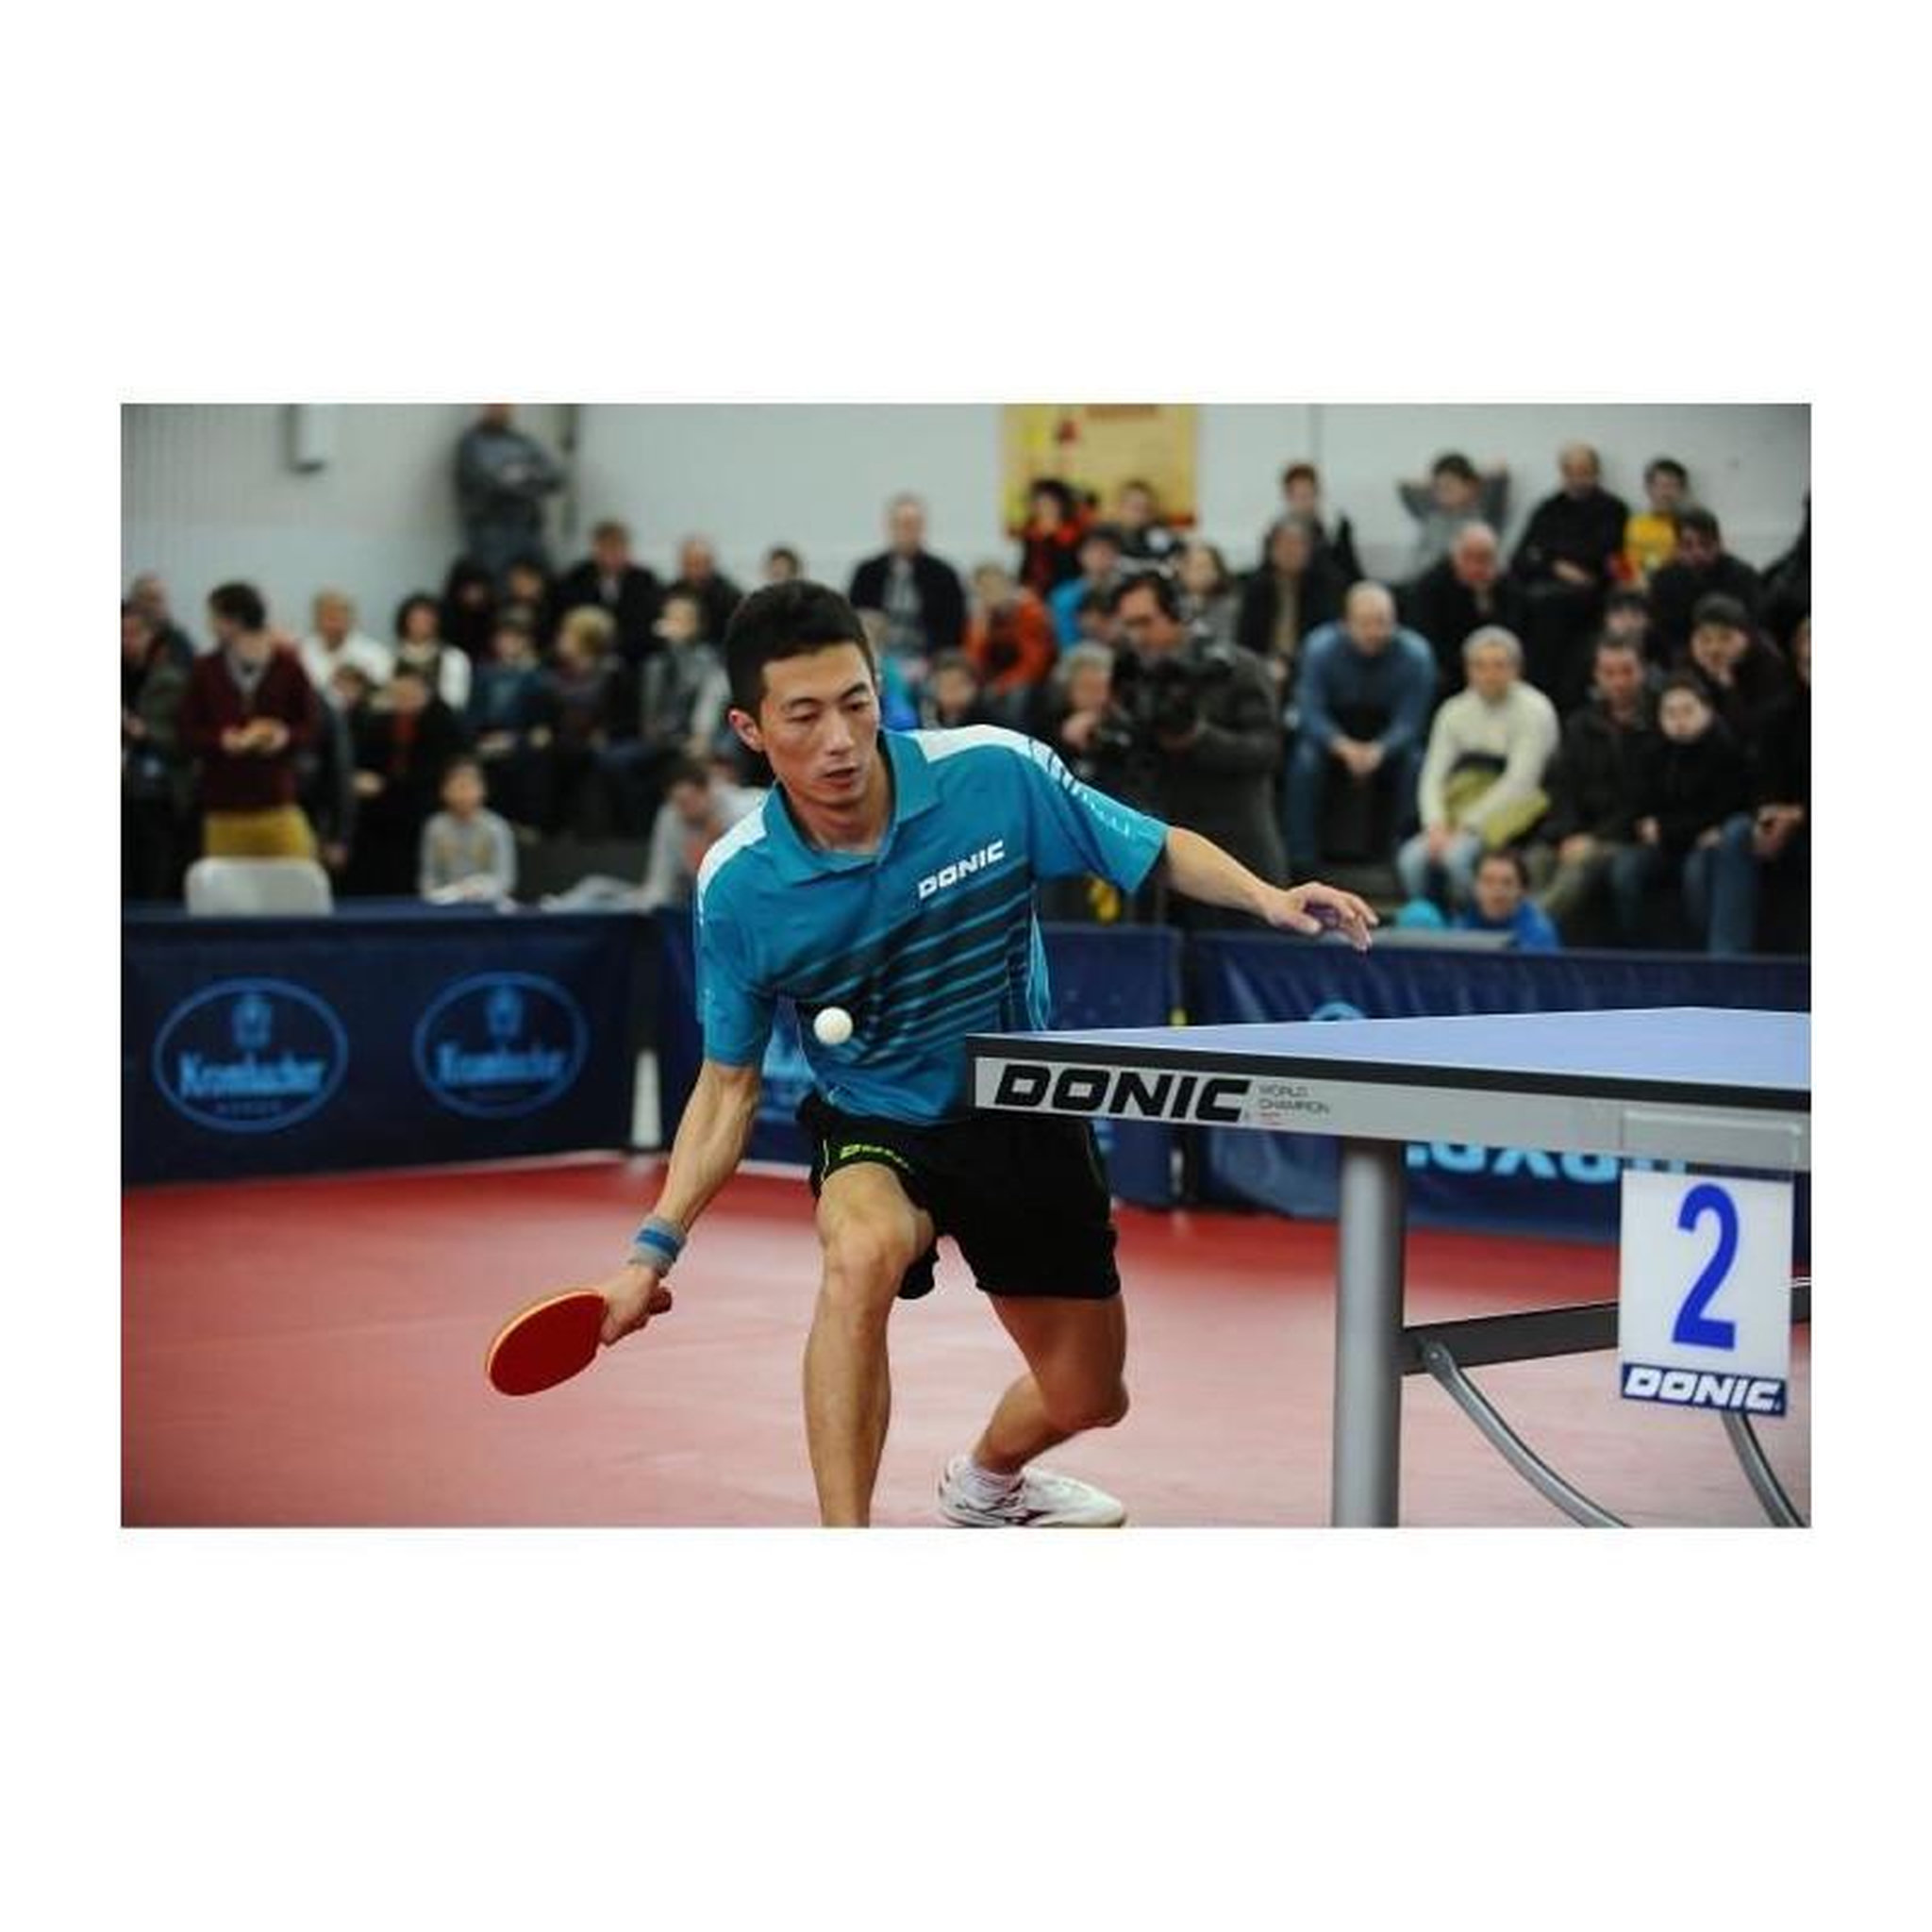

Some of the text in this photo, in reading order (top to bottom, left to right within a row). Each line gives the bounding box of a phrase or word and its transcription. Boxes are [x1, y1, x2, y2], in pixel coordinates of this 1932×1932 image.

[918, 839, 1005, 900] DONIC
[994, 1064, 1251, 1124] DONIC
[1673, 1183, 1740, 1350] 2
[1624, 1368, 1781, 1410] DONIC
